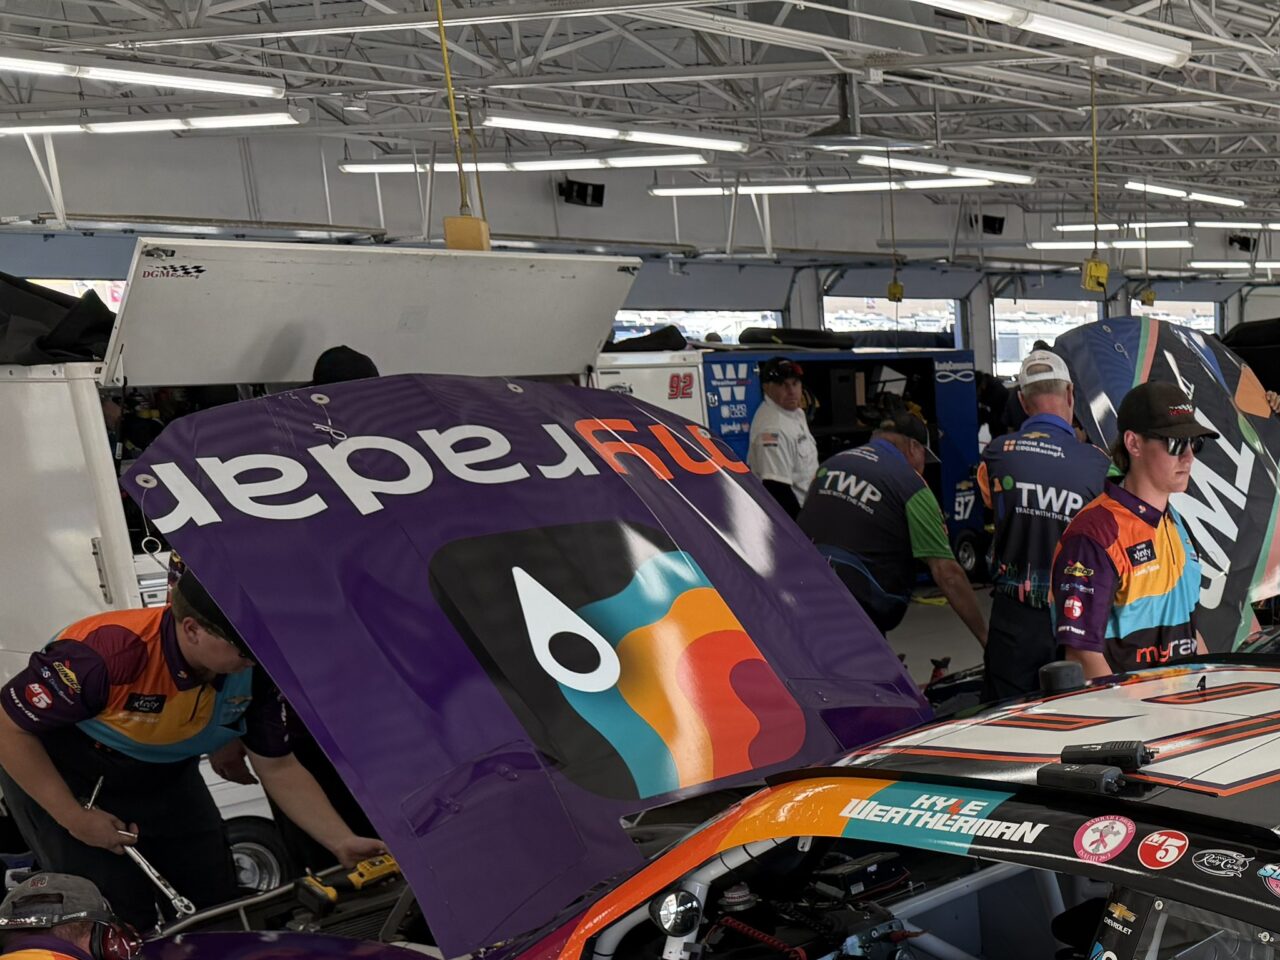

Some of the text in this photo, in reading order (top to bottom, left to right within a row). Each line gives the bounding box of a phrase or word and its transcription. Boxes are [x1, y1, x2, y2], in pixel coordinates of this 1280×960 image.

[667, 372, 694, 399] 92
[150, 417, 751, 534] myradar
[824, 470, 882, 505] TWP
[954, 494, 975, 522] 97
[1015, 481, 1084, 516] TWP
[838, 797, 1051, 844] WEATHERMAN
[910, 794, 989, 816] KYLE
[1144, 832, 1187, 863] M5
[1103, 916, 1133, 936] CHEVROLET
